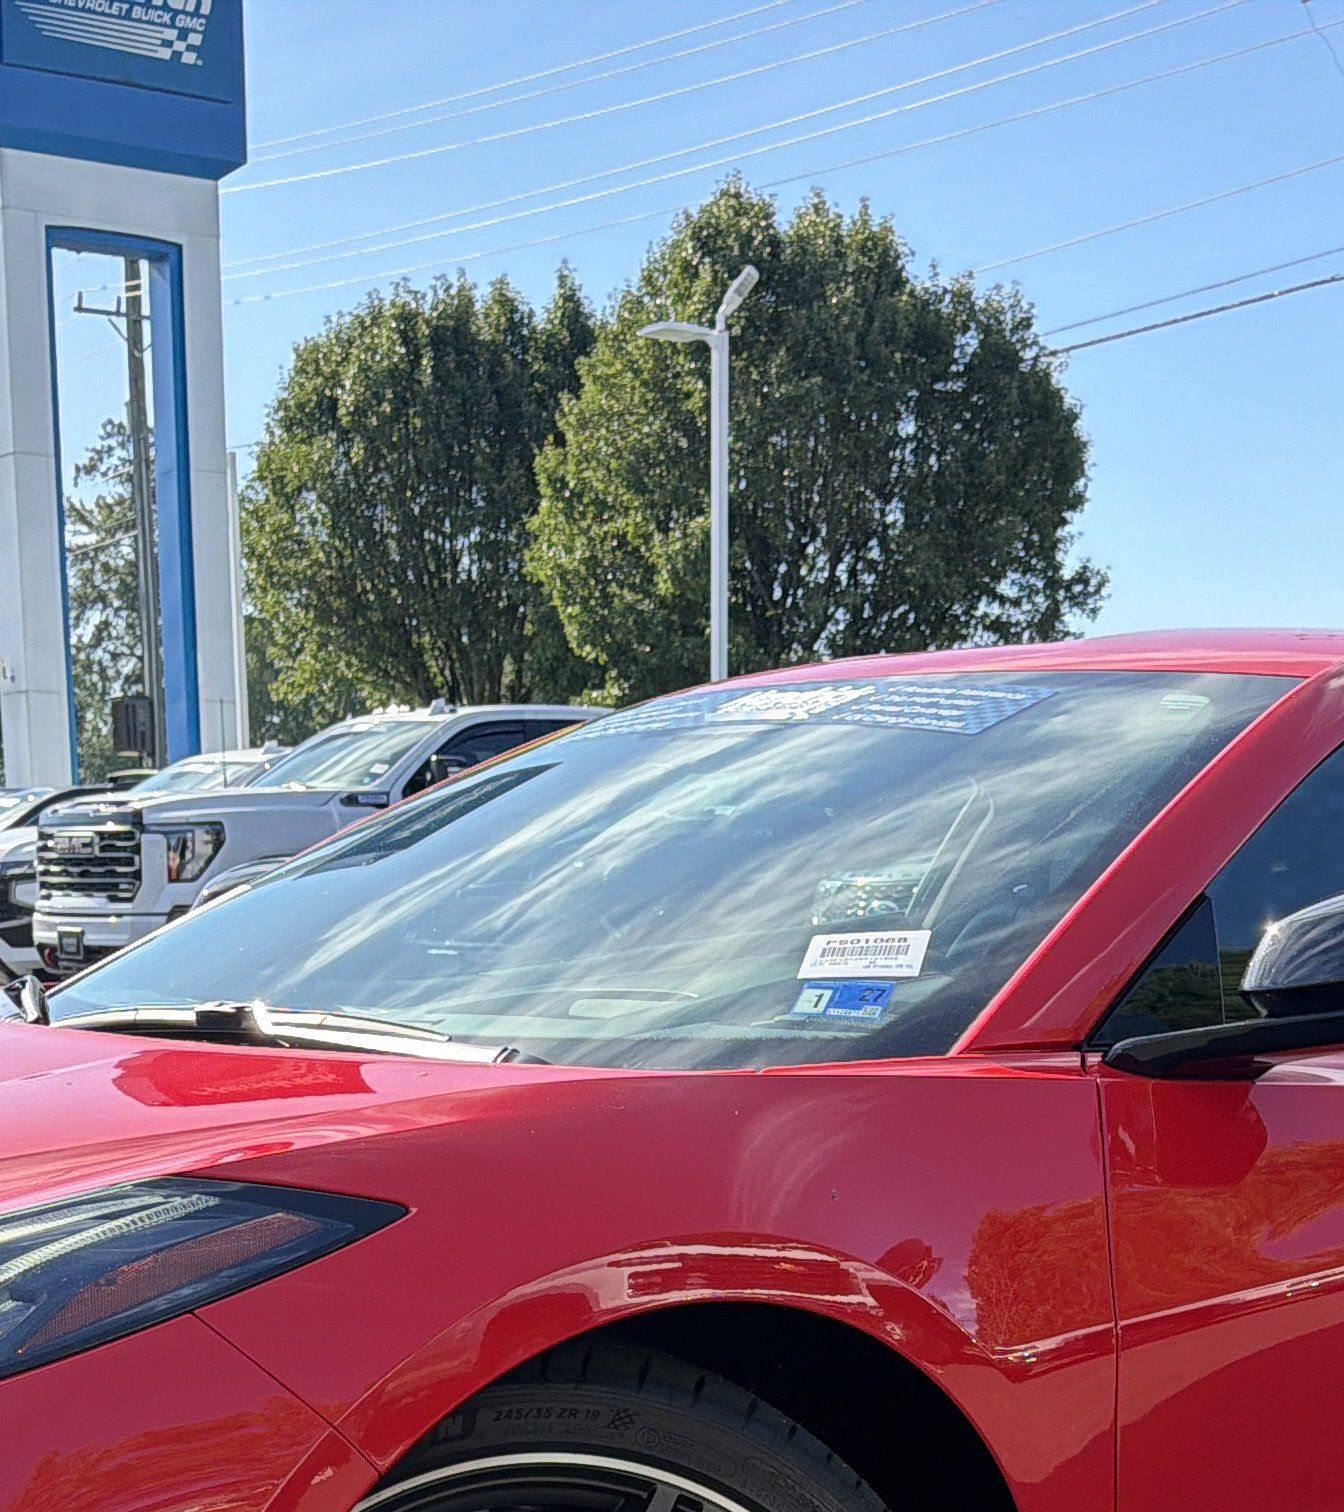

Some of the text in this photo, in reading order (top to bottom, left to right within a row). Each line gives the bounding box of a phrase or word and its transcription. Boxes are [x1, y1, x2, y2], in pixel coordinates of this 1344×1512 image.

[48, 0, 130, 17] EVROLET
[131, 5, 173, 26] BUICK
[175, 14, 207, 31] GMC
[858, 987, 887, 1003] 27
[493, 1406, 601, 1421] 245/35 ZR 19
